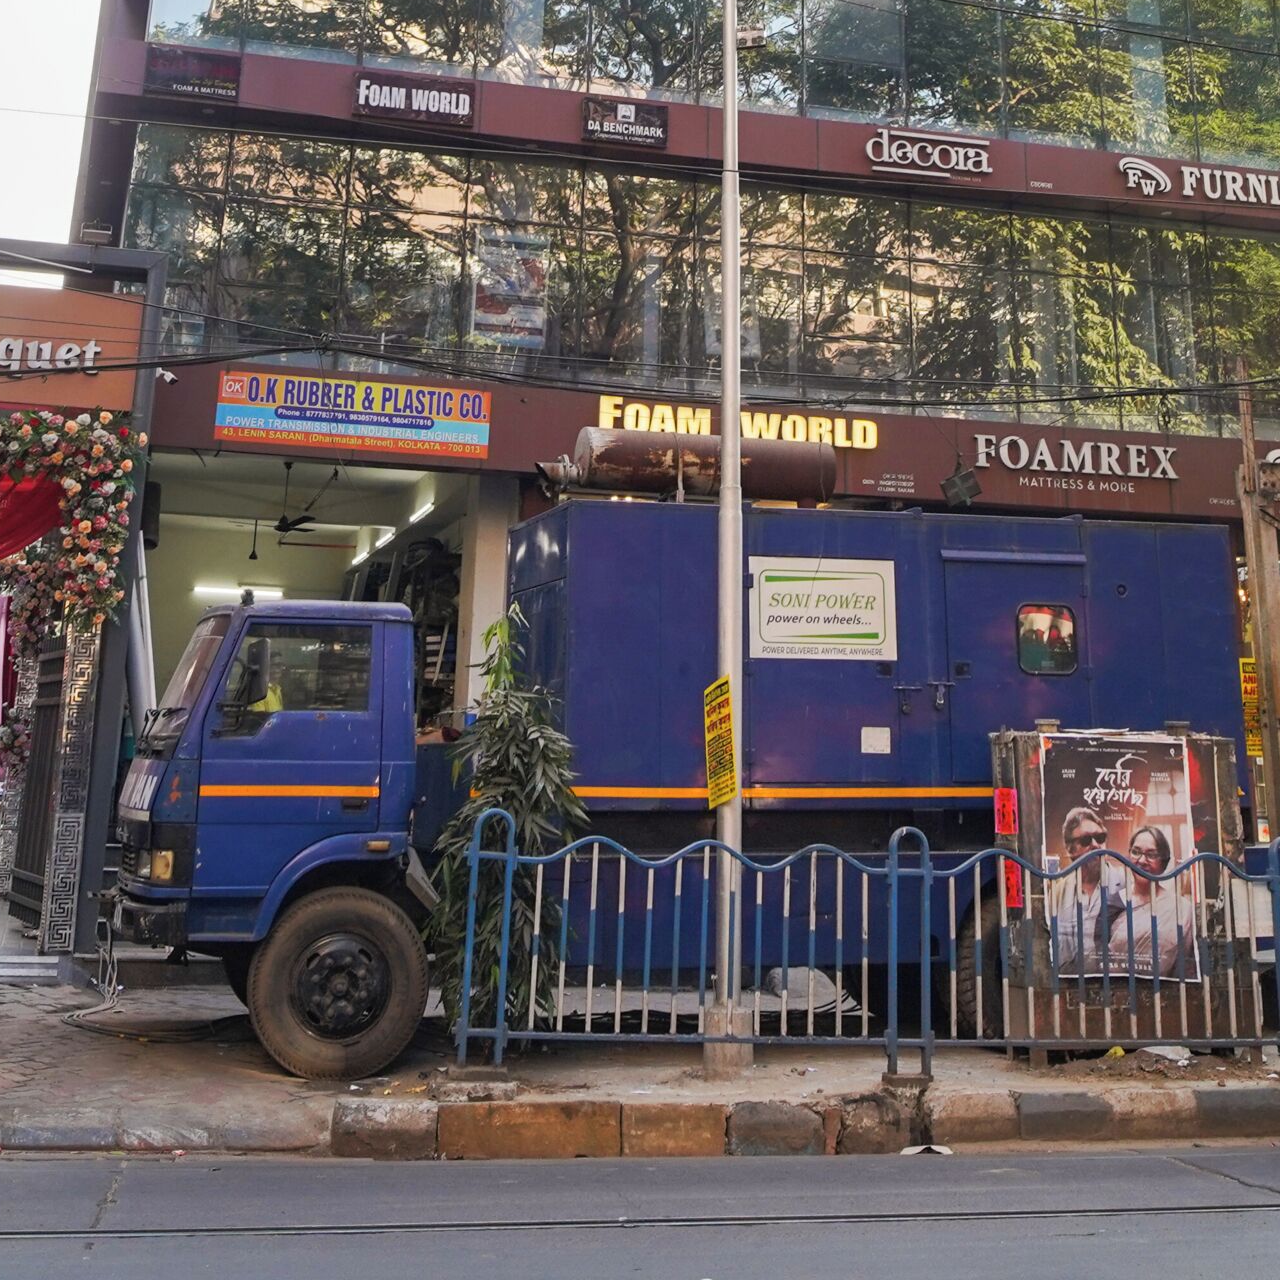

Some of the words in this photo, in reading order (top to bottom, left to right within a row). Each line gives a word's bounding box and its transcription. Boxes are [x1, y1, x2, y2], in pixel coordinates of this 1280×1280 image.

[173, 83, 193, 92] FOAM
[201, 87, 237, 97] MATTRESS
[358, 79, 406, 110] FOAM
[411, 88, 470, 116] WORLD
[587, 120, 601, 131] DA
[603, 121, 664, 138] BENCHMARK
[865, 128, 993, 173] decora
[225, 381, 243, 393] OK
[247, 376, 279, 404] O.K
[283, 379, 357, 410] RUBBER
[361, 385, 376, 411] &
[381, 386, 454, 418] PLASTIC
[459, 392, 487, 420] CO.
[277, 408, 300, 417] Phone
[598, 395, 712, 436] FOAM
[739, 411, 878, 449] WORLD
[225, 415, 265, 427] POWER
[268, 418, 345, 434] TRANSMISSION
[347, 426, 355, 435] &
[358, 425, 419, 440] INDUSTRIAL
[421, 429, 480, 443] ENGINEERS
[222, 427, 236, 437] 43,
[238, 428, 266, 438] LENIN
[268, 430, 307, 442] SARANI,
[308, 434, 362, 446] (Dharmatala
[398, 441, 441, 451] KOLKATA
[448, 444, 463, 453] 700
[465, 445, 481, 454] 013
[974, 434, 1180, 480] FOAMREX
[1019, 476, 1084, 491] MATTRESS
[1087, 480, 1096, 492] &
[1099, 481, 1136, 494] MORE
[769, 592, 812, 608] SONI
[815, 592, 877, 611] POWER
[766, 614, 804, 626] power
[805, 616, 820, 624] on
[823, 614, 872, 626] wheels...
[762, 646, 786, 655] POWER
